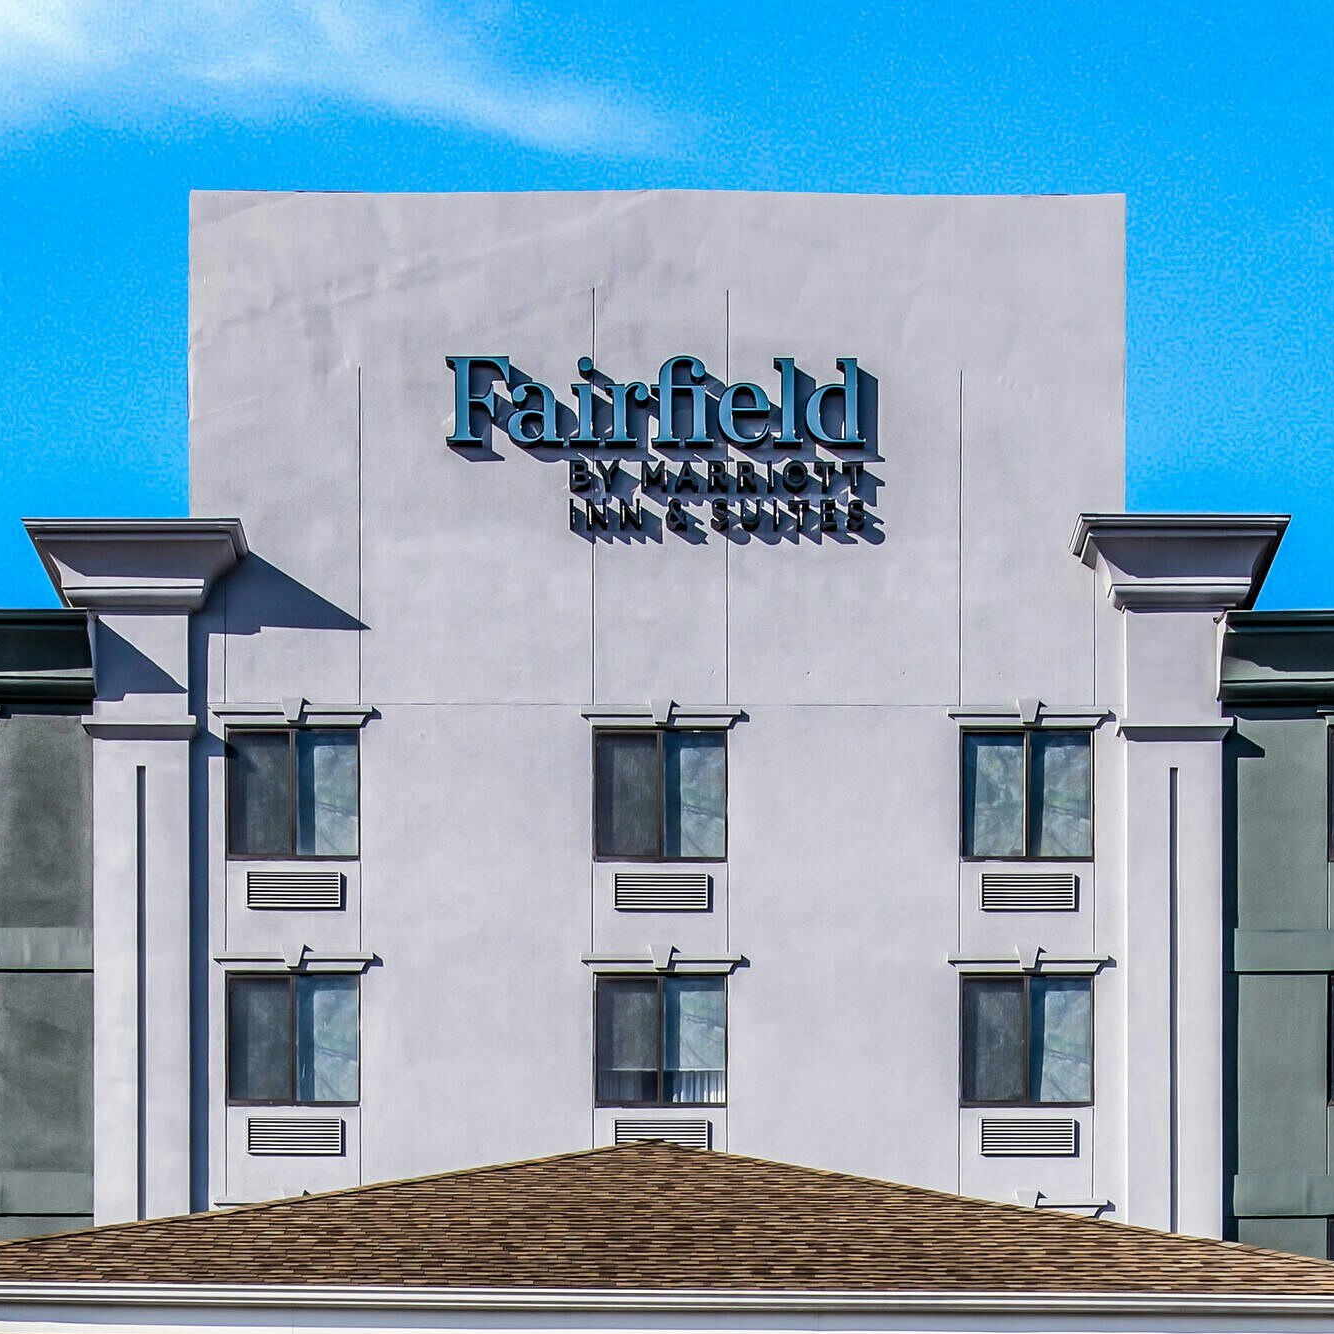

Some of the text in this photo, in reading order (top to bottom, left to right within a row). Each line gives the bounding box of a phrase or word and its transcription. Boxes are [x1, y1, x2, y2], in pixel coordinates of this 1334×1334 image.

[445, 355, 866, 449] Fairfield
[569, 459, 865, 494] BY MARRIOTT
[569, 497, 866, 532] INN & SUITES
